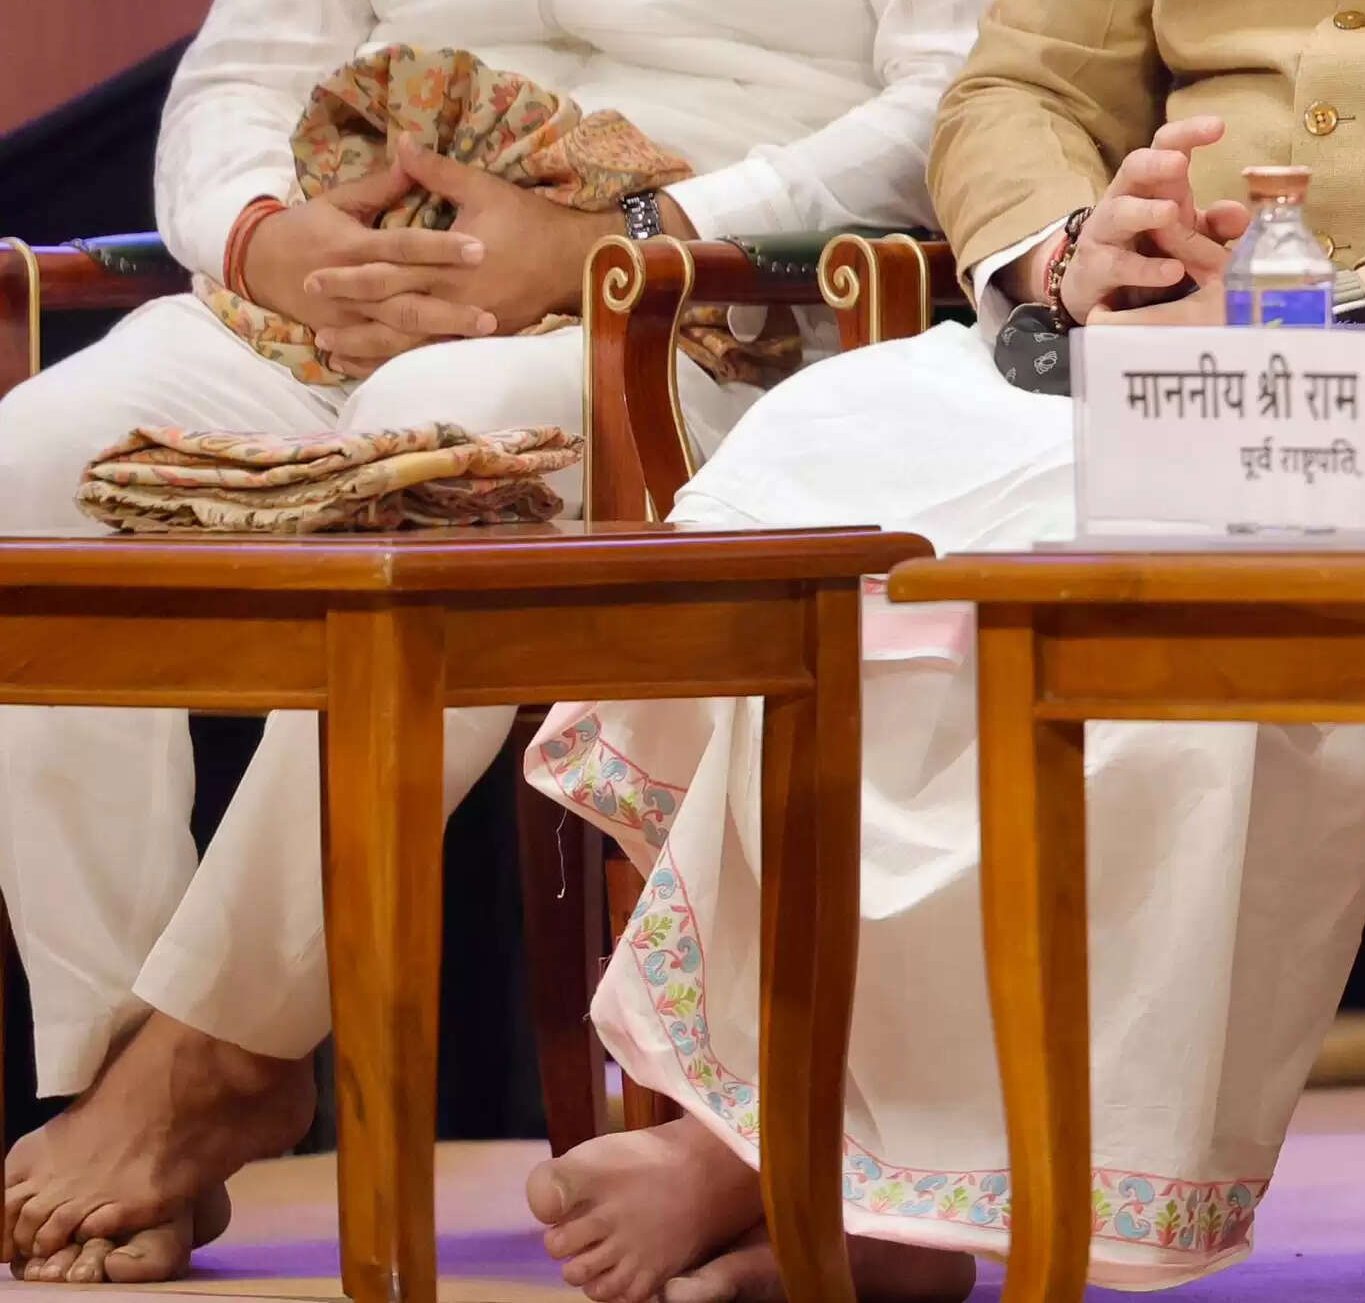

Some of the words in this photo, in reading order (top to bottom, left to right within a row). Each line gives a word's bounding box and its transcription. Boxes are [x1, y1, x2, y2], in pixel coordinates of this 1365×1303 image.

[1124, 353, 1246, 419] माननीय
[1258, 354, 1291, 418] श्री
[1304, 372, 1359, 420] राम
[1240, 437, 1273, 478] पूर्व
